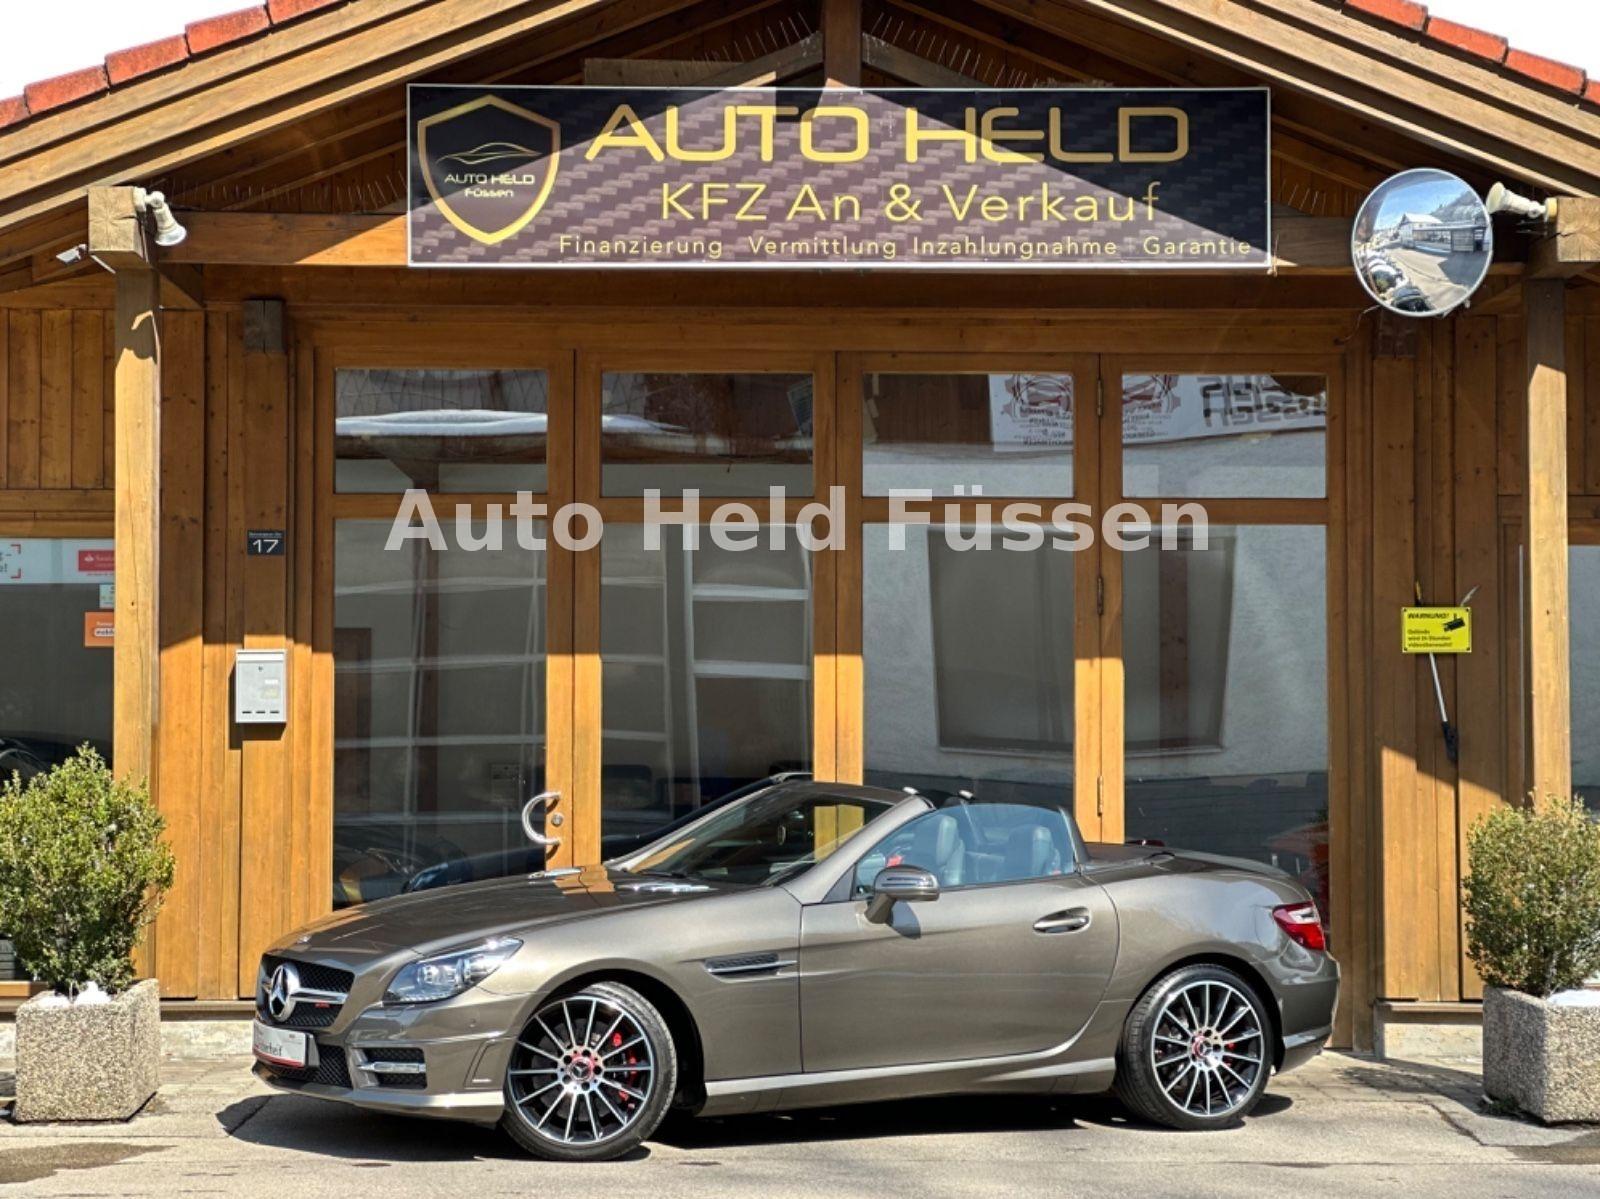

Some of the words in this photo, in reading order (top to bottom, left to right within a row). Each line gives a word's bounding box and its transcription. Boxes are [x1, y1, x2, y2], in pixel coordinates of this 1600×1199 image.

[585, 103, 870, 163] AUTO
[905, 106, 1190, 163] HELD
[444, 173, 488, 184] AUTO
[490, 174, 536, 185] HELD
[661, 183, 767, 221] KFZ
[786, 183, 861, 221] An
[884, 183, 923, 221] &
[942, 181, 1161, 222] Verkauf
[559, 234, 723, 258] Finanzierung
[748, 234, 897, 259] Vermittlung
[913, 235, 1117, 259] Inzahlungnahme
[1143, 235, 1251, 256] Garantie
[252, 539, 279, 553] 17
